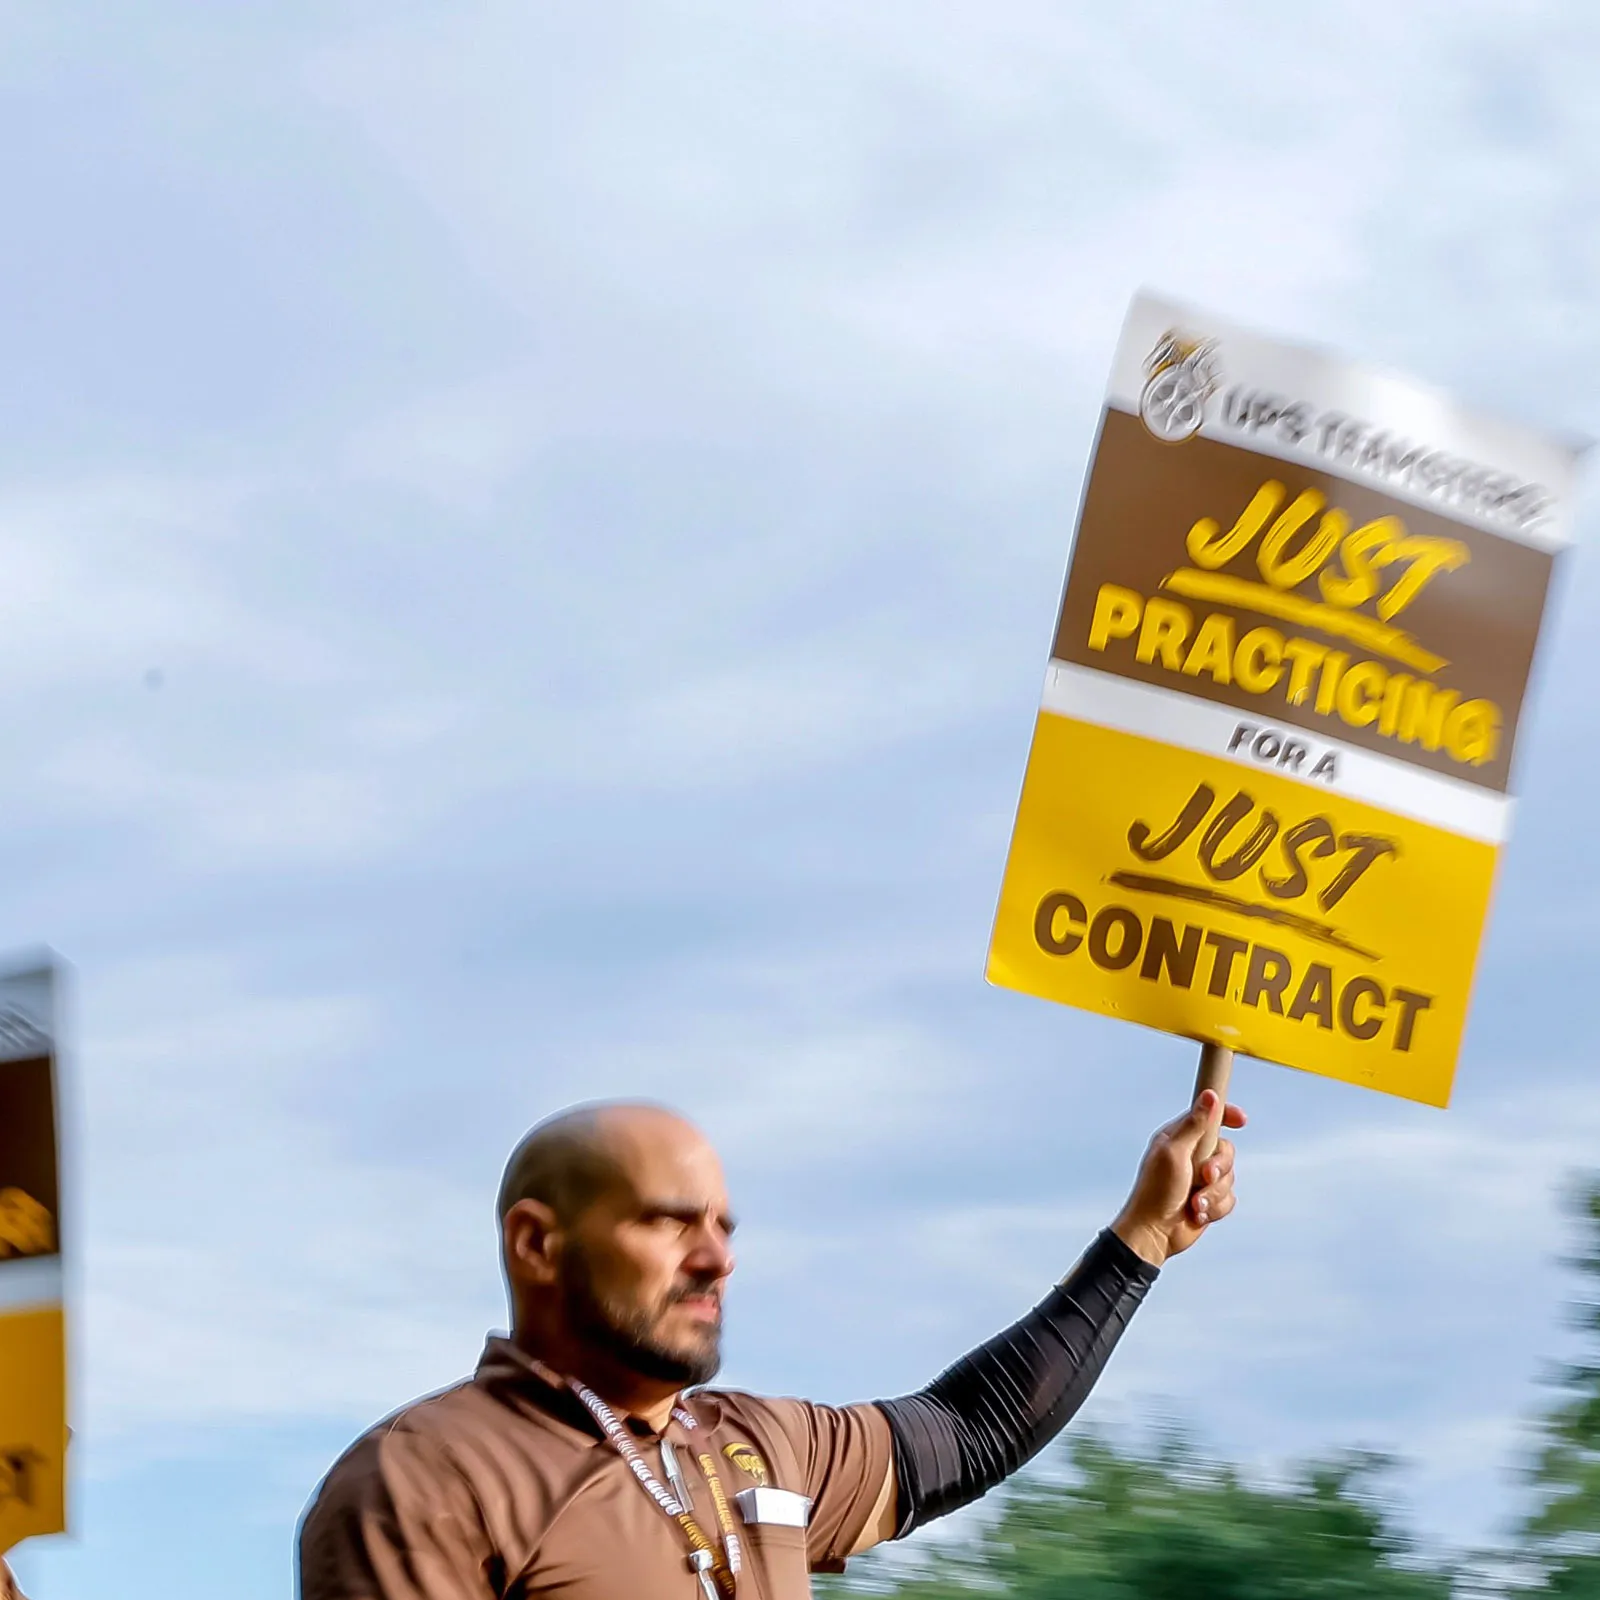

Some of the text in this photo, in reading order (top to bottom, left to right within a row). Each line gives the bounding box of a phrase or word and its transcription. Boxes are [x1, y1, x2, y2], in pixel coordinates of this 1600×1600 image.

[1221, 384, 1315, 446] UPS
[1186, 478, 1471, 621] JUST
[1088, 585, 1500, 765] PRACTICING
[1226, 721, 1342, 785] FOR A
[1128, 784, 1401, 913] JUST
[1032, 890, 1432, 1053] CONTRACT
